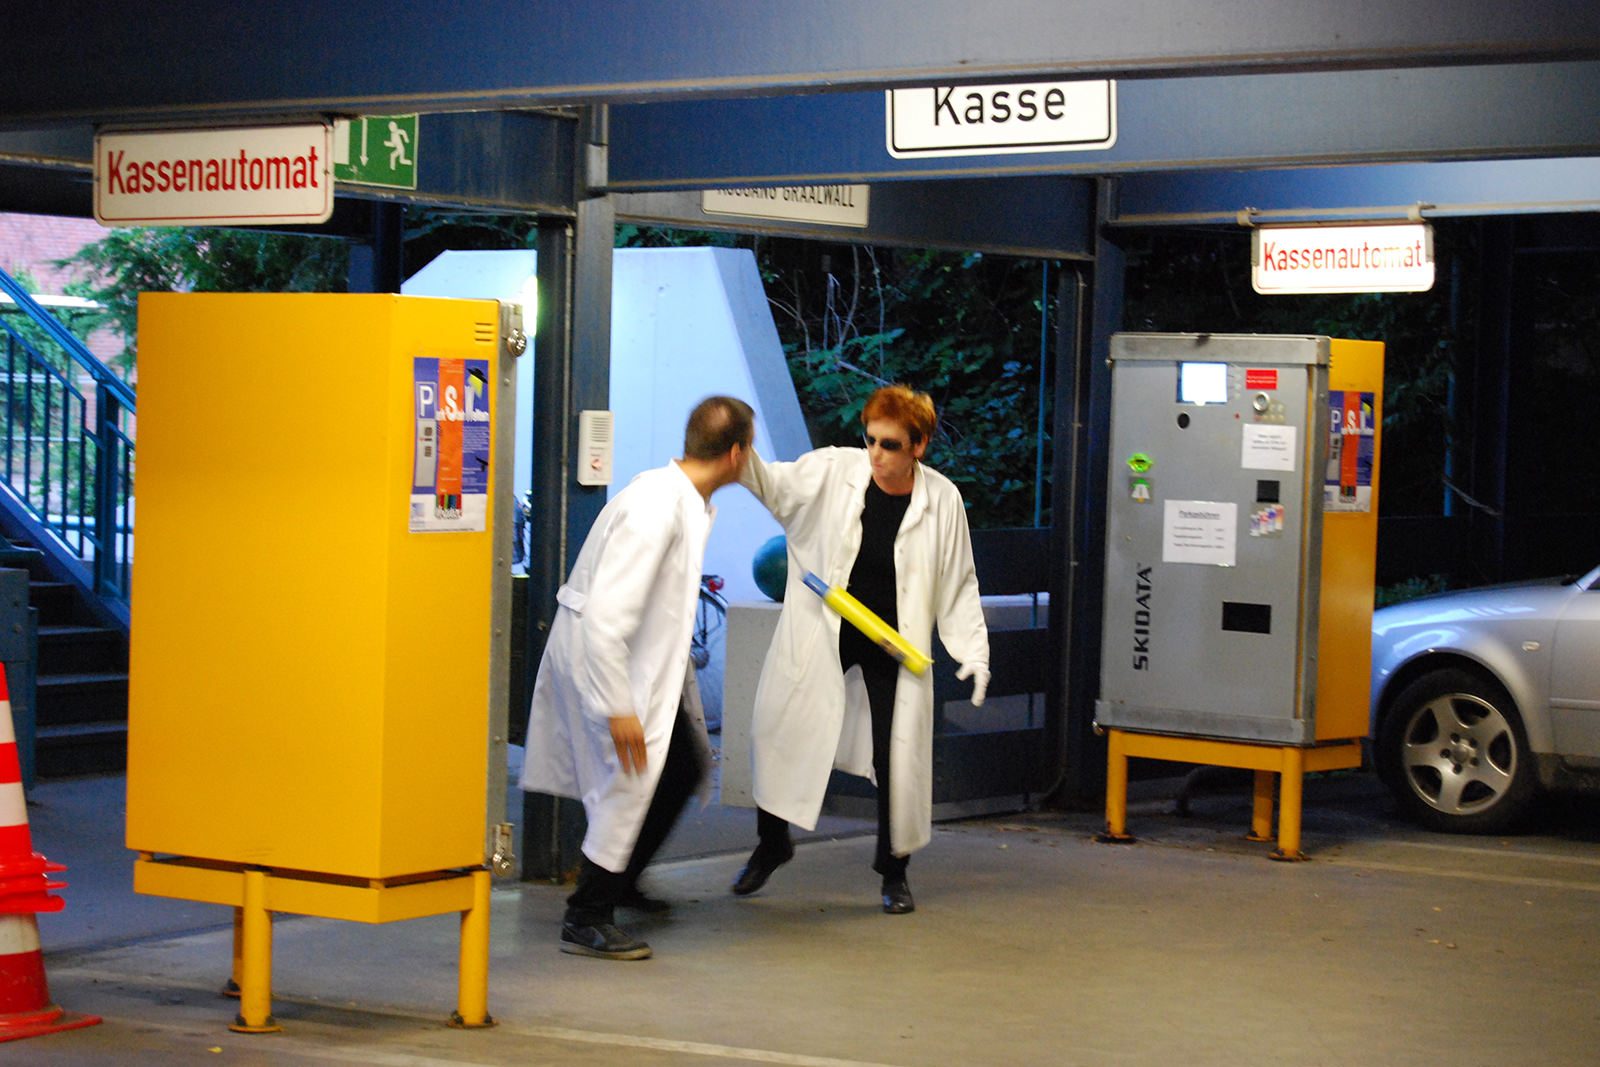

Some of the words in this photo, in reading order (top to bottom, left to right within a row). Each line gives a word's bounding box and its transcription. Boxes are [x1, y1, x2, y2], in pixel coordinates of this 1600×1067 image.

[934, 86, 1066, 127] Kasse
[108, 146, 319, 194] Kassenautomat
[1263, 239, 1422, 272] Kassenautomat
[1133, 566, 1153, 671] SKIDATA
